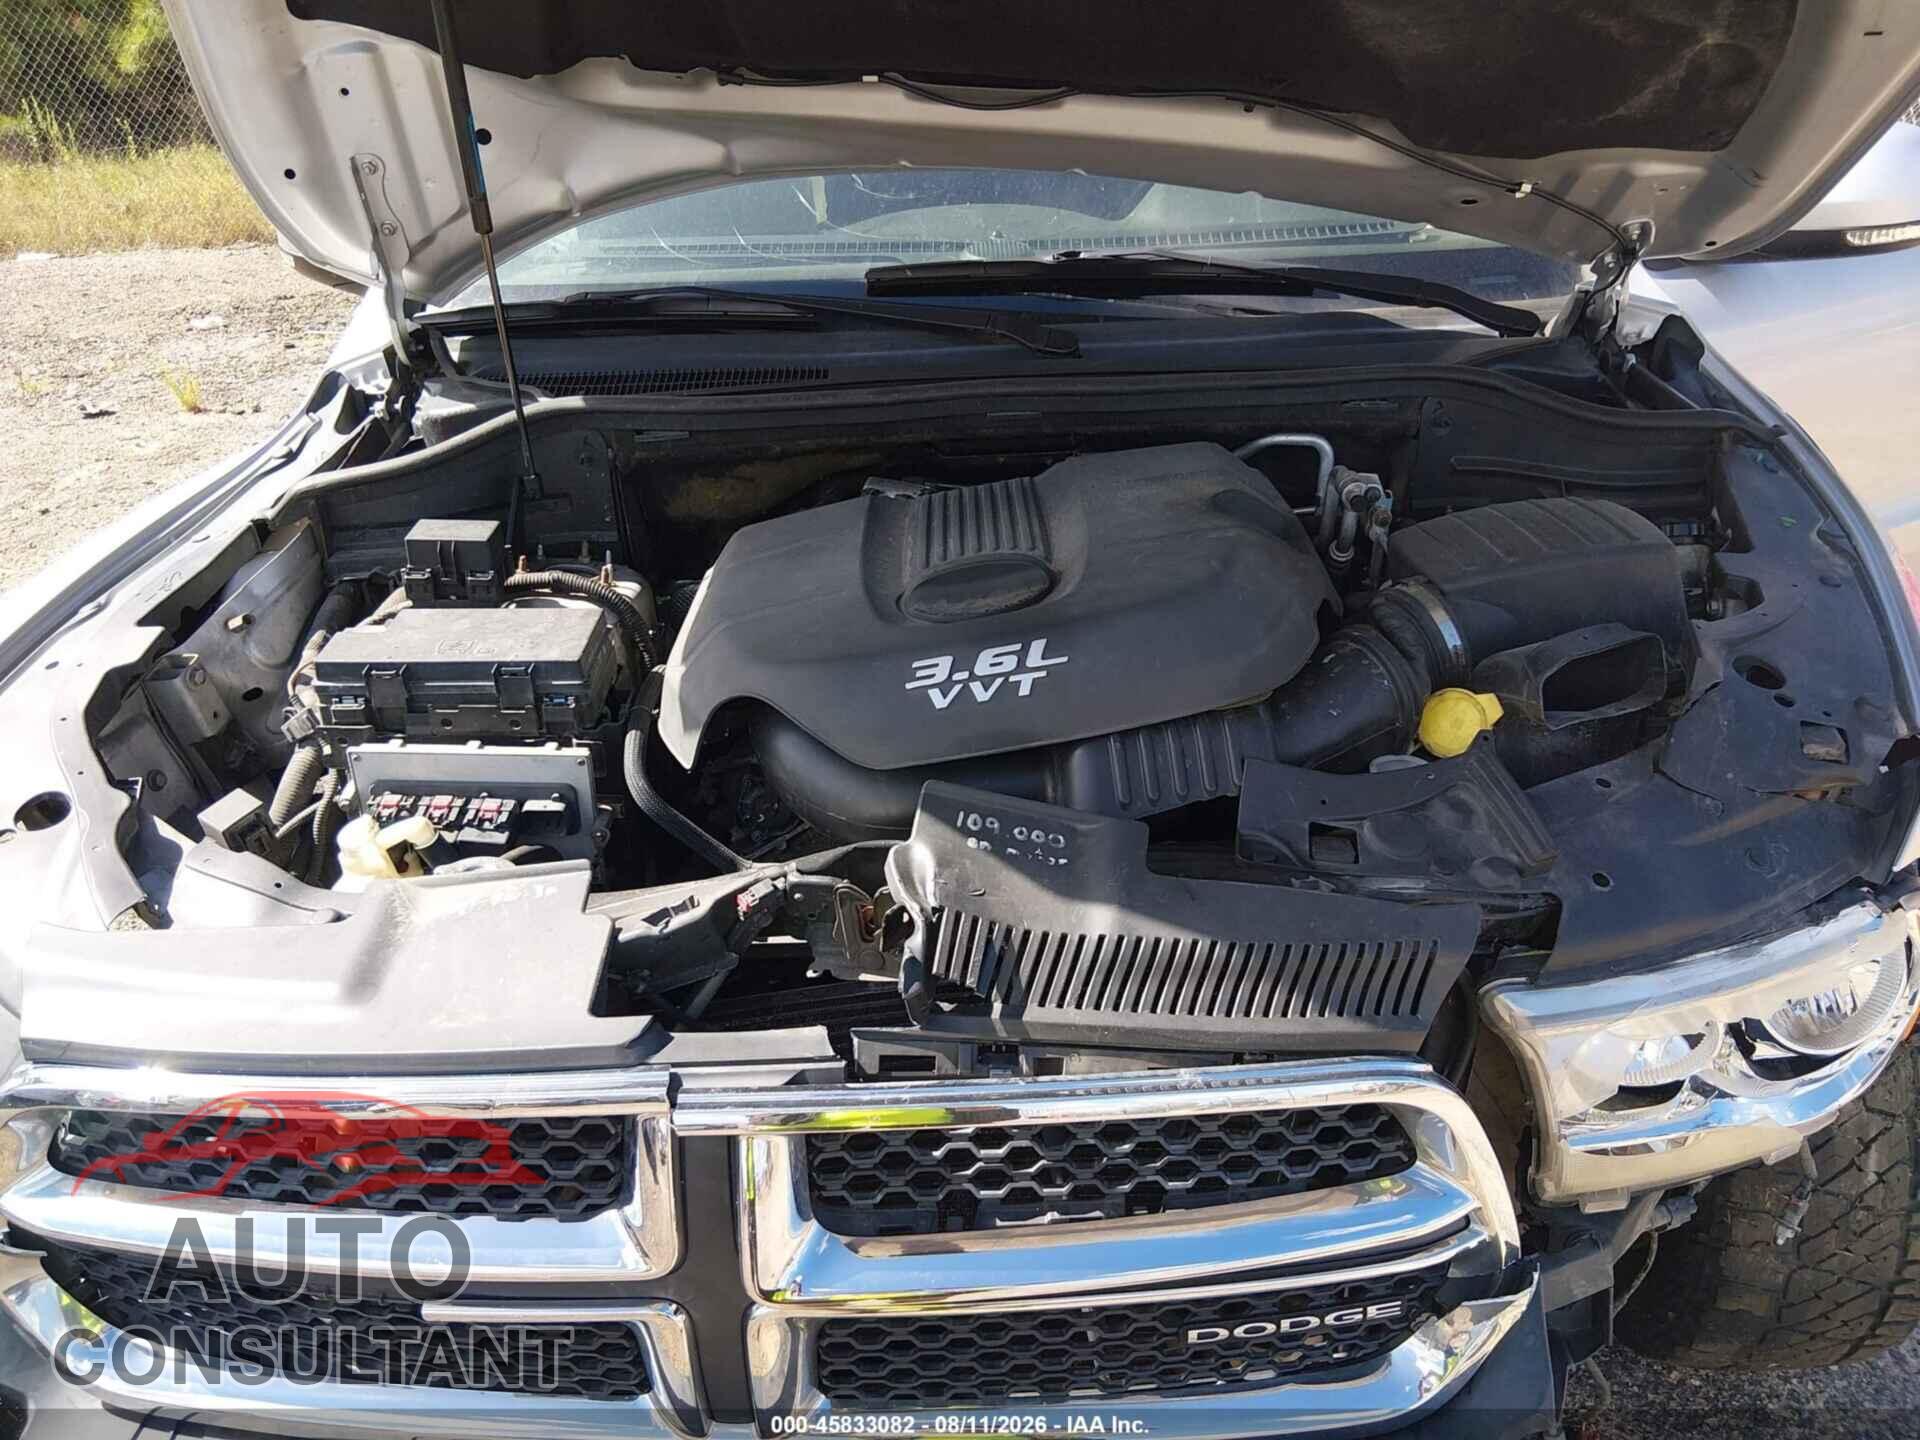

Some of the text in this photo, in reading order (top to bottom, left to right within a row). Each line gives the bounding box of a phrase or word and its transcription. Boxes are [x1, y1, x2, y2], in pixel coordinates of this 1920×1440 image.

[905, 638, 1069, 690] 3.6L
[928, 671, 1047, 709] VVT
[1187, 1301, 1402, 1344] DODGE
